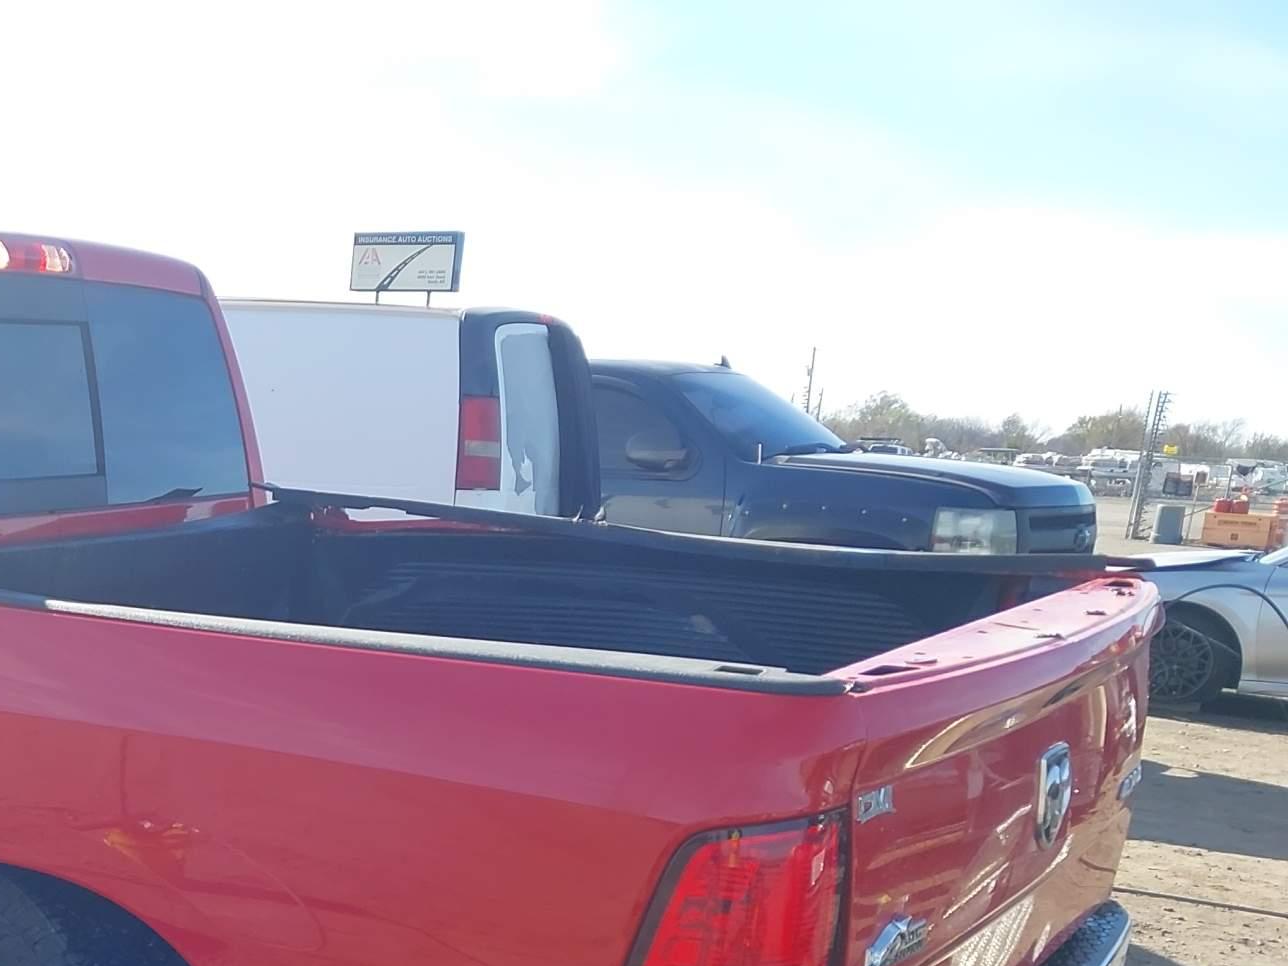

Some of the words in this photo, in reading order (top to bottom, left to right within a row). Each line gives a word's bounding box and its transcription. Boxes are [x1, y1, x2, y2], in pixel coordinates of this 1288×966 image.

[359, 235, 397, 243] INSURANCE
[398, 235, 416, 243] AUTO
[417, 235, 452, 243] AUCTIONS
